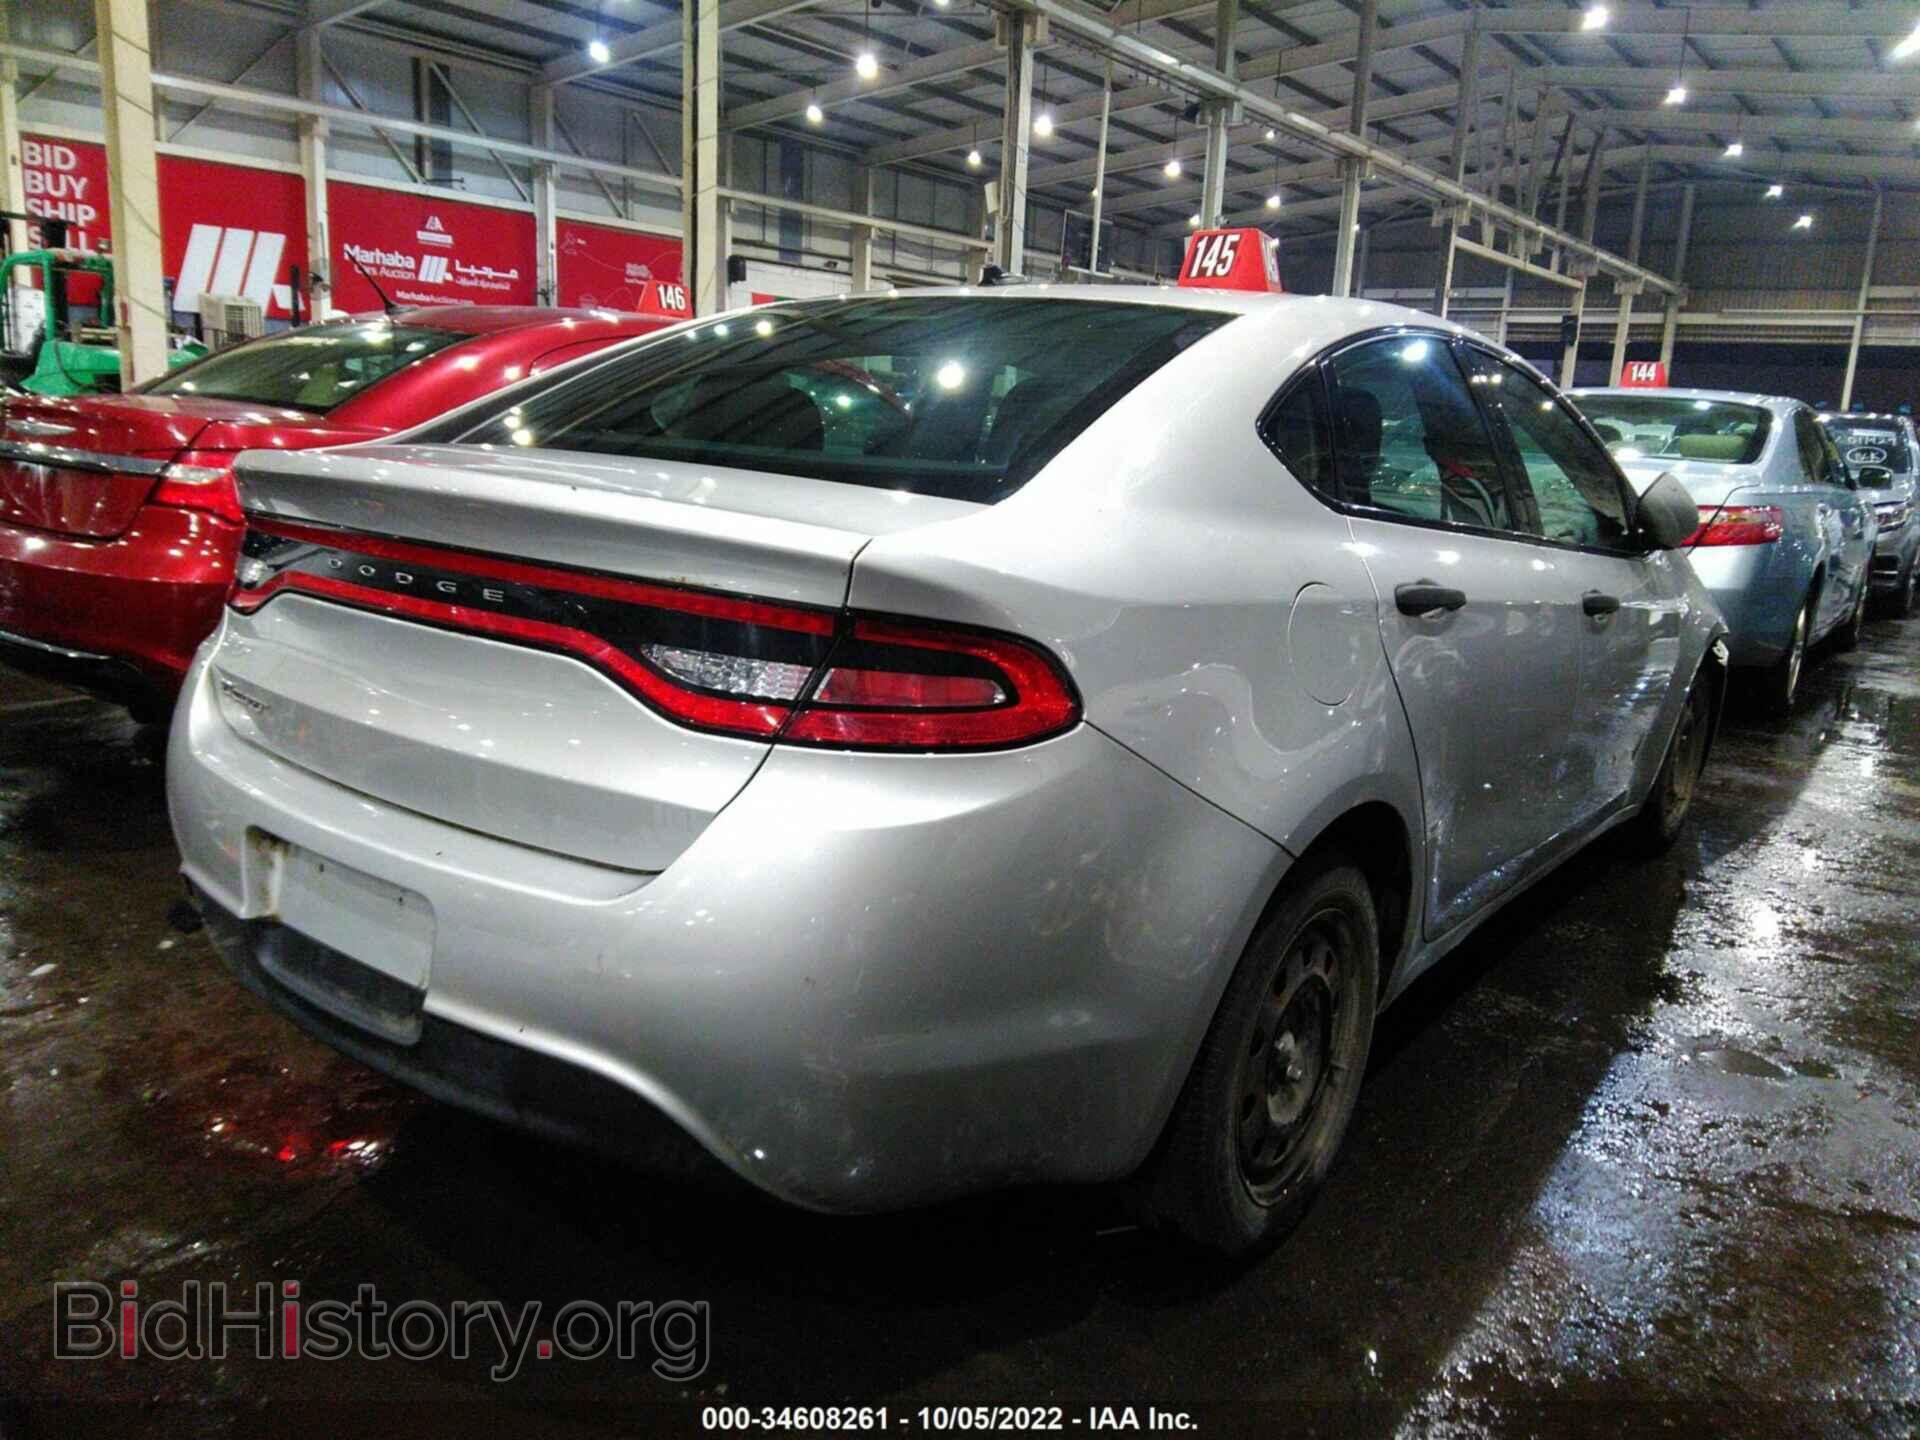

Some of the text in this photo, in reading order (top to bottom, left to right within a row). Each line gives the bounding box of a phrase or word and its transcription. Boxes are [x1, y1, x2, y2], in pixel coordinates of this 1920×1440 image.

[22, 140, 77, 171] BID
[24, 168, 88, 200] BUY
[26, 197, 97, 228] SHIP
[28, 225, 98, 255] SLL
[343, 243, 416, 270] Marhaba
[1189, 233, 1242, 279] 145
[354, 264, 416, 280] Crs Auction
[656, 283, 687, 311] 146
[1631, 362, 1657, 381] 144
[327, 557, 505, 602] DODGE
